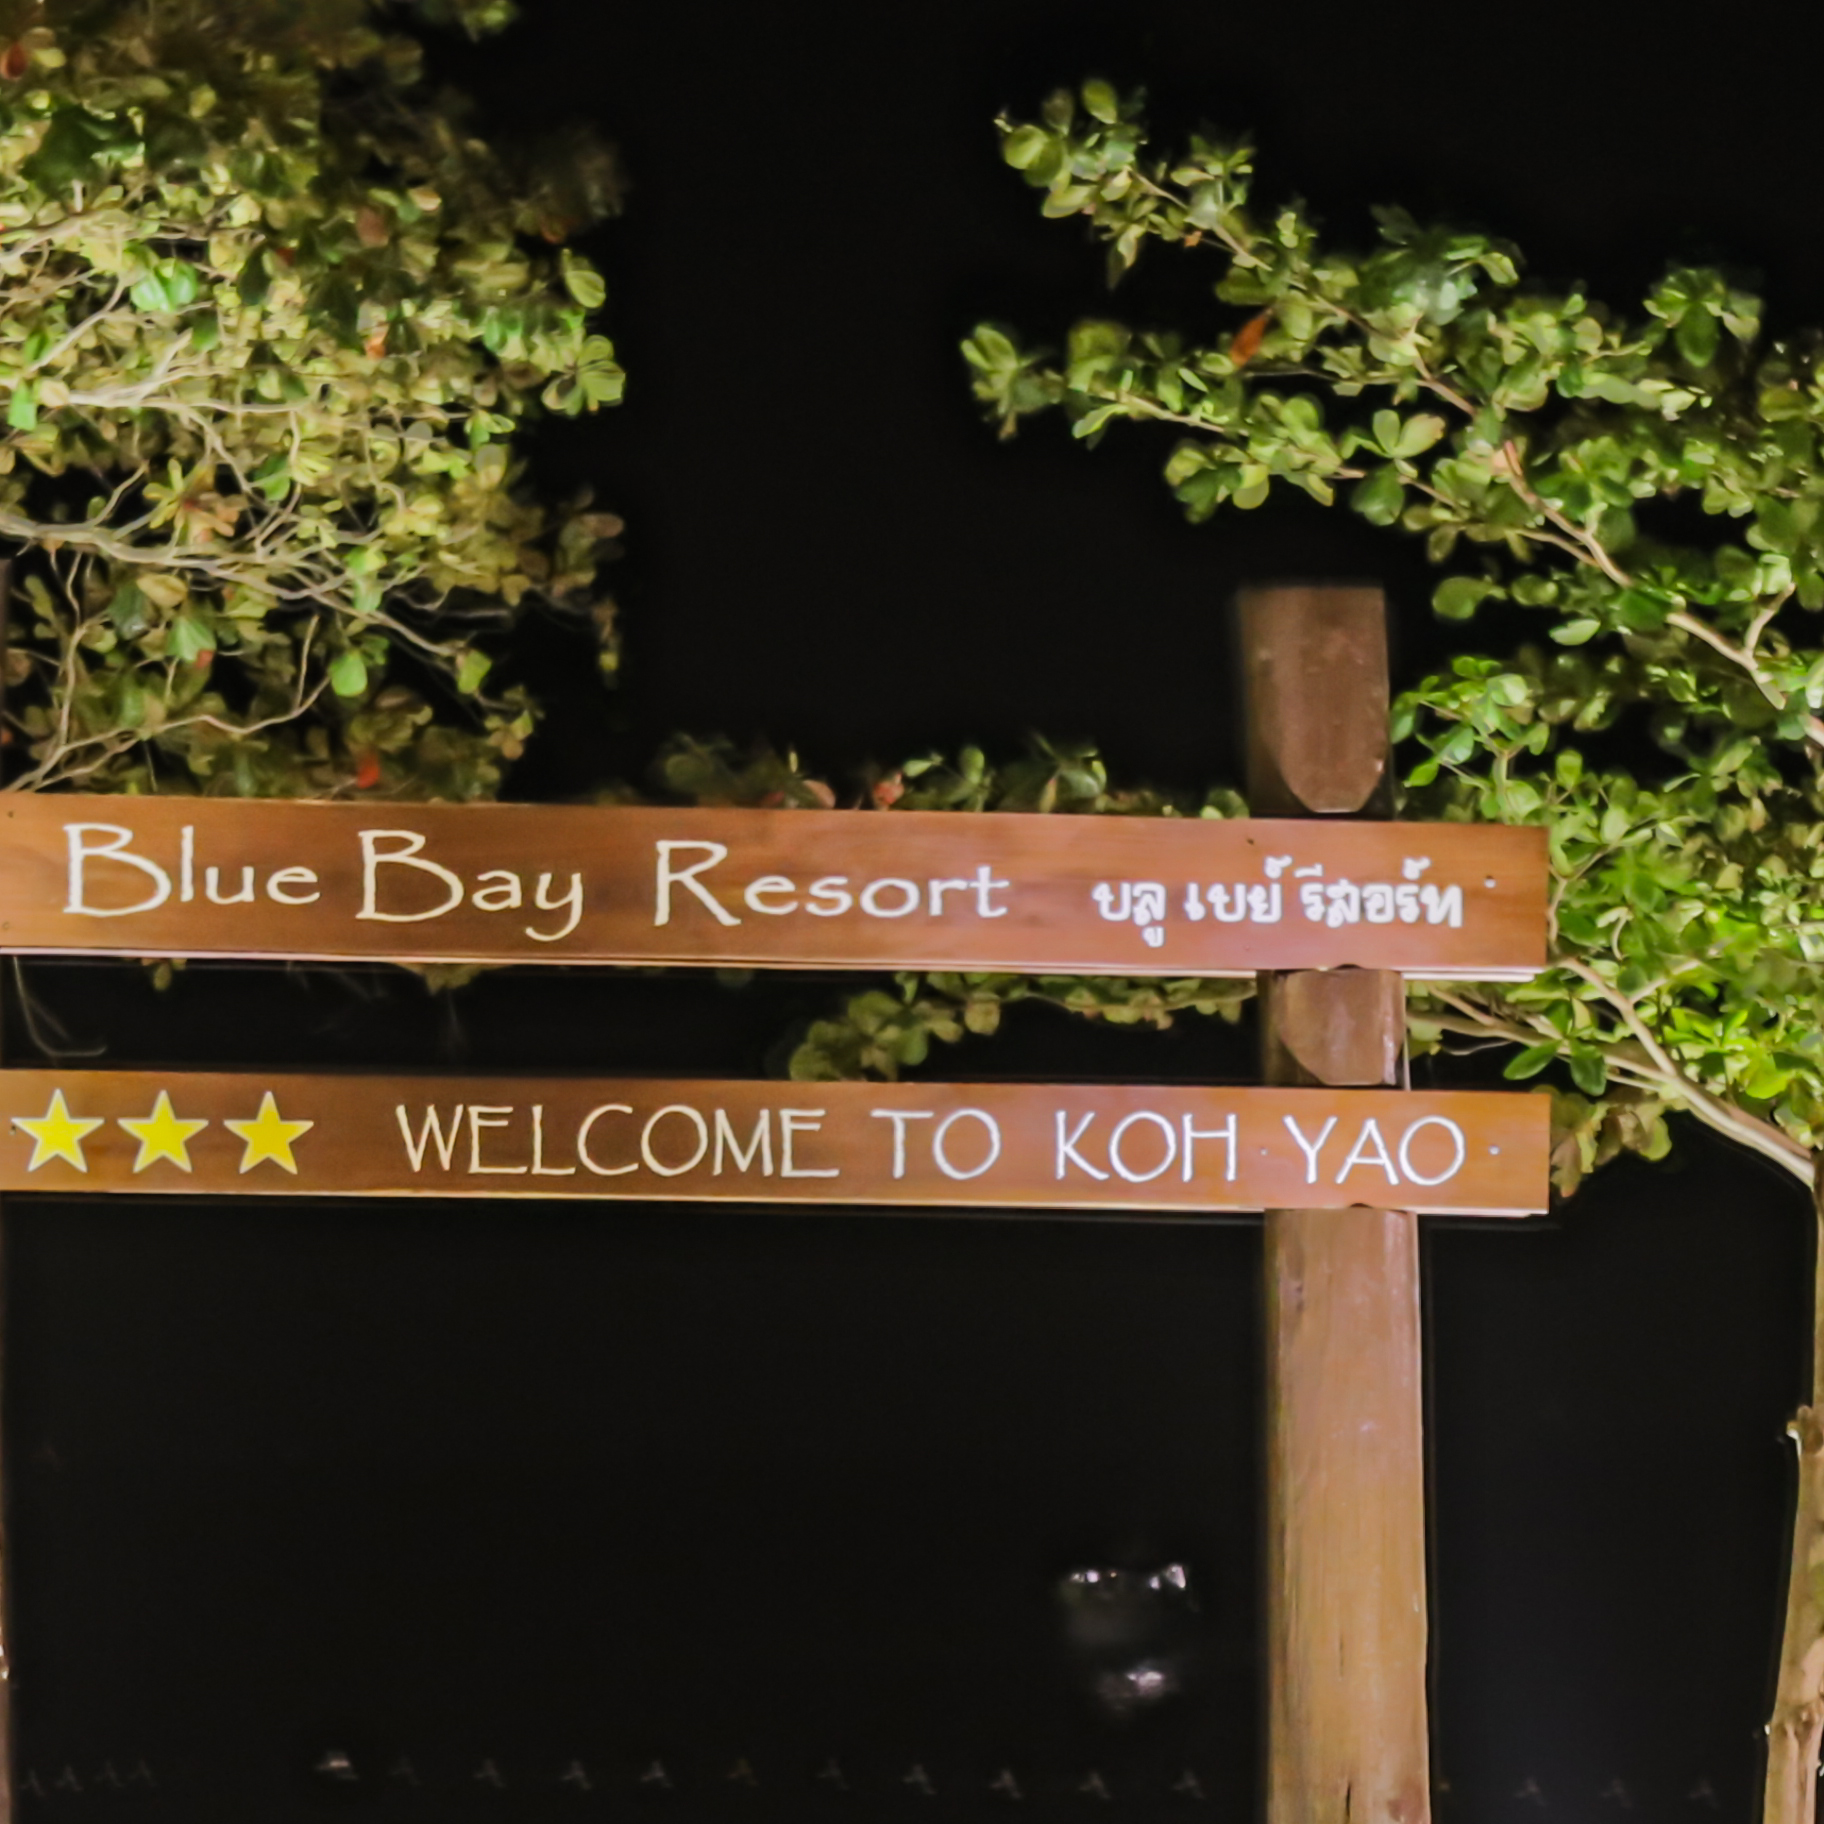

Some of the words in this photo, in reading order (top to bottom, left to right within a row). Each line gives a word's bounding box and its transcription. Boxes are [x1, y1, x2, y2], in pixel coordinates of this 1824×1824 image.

[62, 822, 321, 918] Blue
[355, 829, 584, 941] Bay
[653, 839, 1010, 926] Resort
[1090, 880, 1167, 948] บลู
[1182, 854, 1293, 924] เบย์
[1293, 856, 1463, 929] รีสอร์ท
[395, 1104, 840, 1178] WELCOME
[869, 1107, 1002, 1180] TO
[1054, 1108, 1238, 1184] KOH
[1281, 1113, 1467, 1187] YAO
